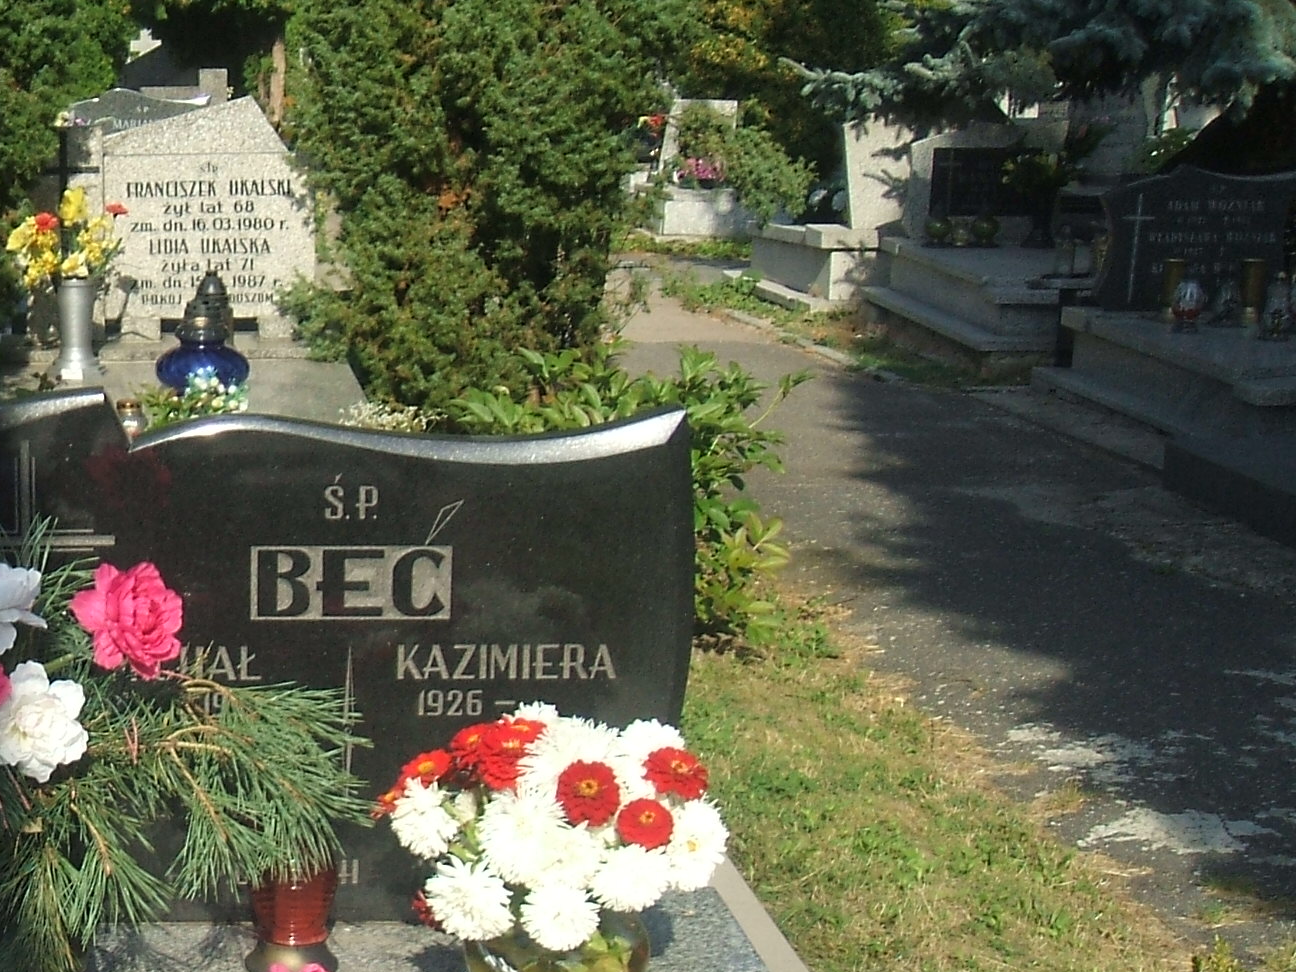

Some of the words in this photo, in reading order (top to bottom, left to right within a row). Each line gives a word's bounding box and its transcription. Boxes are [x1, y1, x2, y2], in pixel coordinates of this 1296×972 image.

[126, 180, 217, 198] FRANCISZEK
[229, 179, 291, 197] UKALSKI
[200, 202, 223, 214] lat
[234, 201, 255, 213] 68
[149, 239, 188, 255] LIDIA
[201, 238, 271, 254] UKALSKA
[396, 643, 617, 681] KAZIMIERA
[417, 689, 483, 717] 1926
